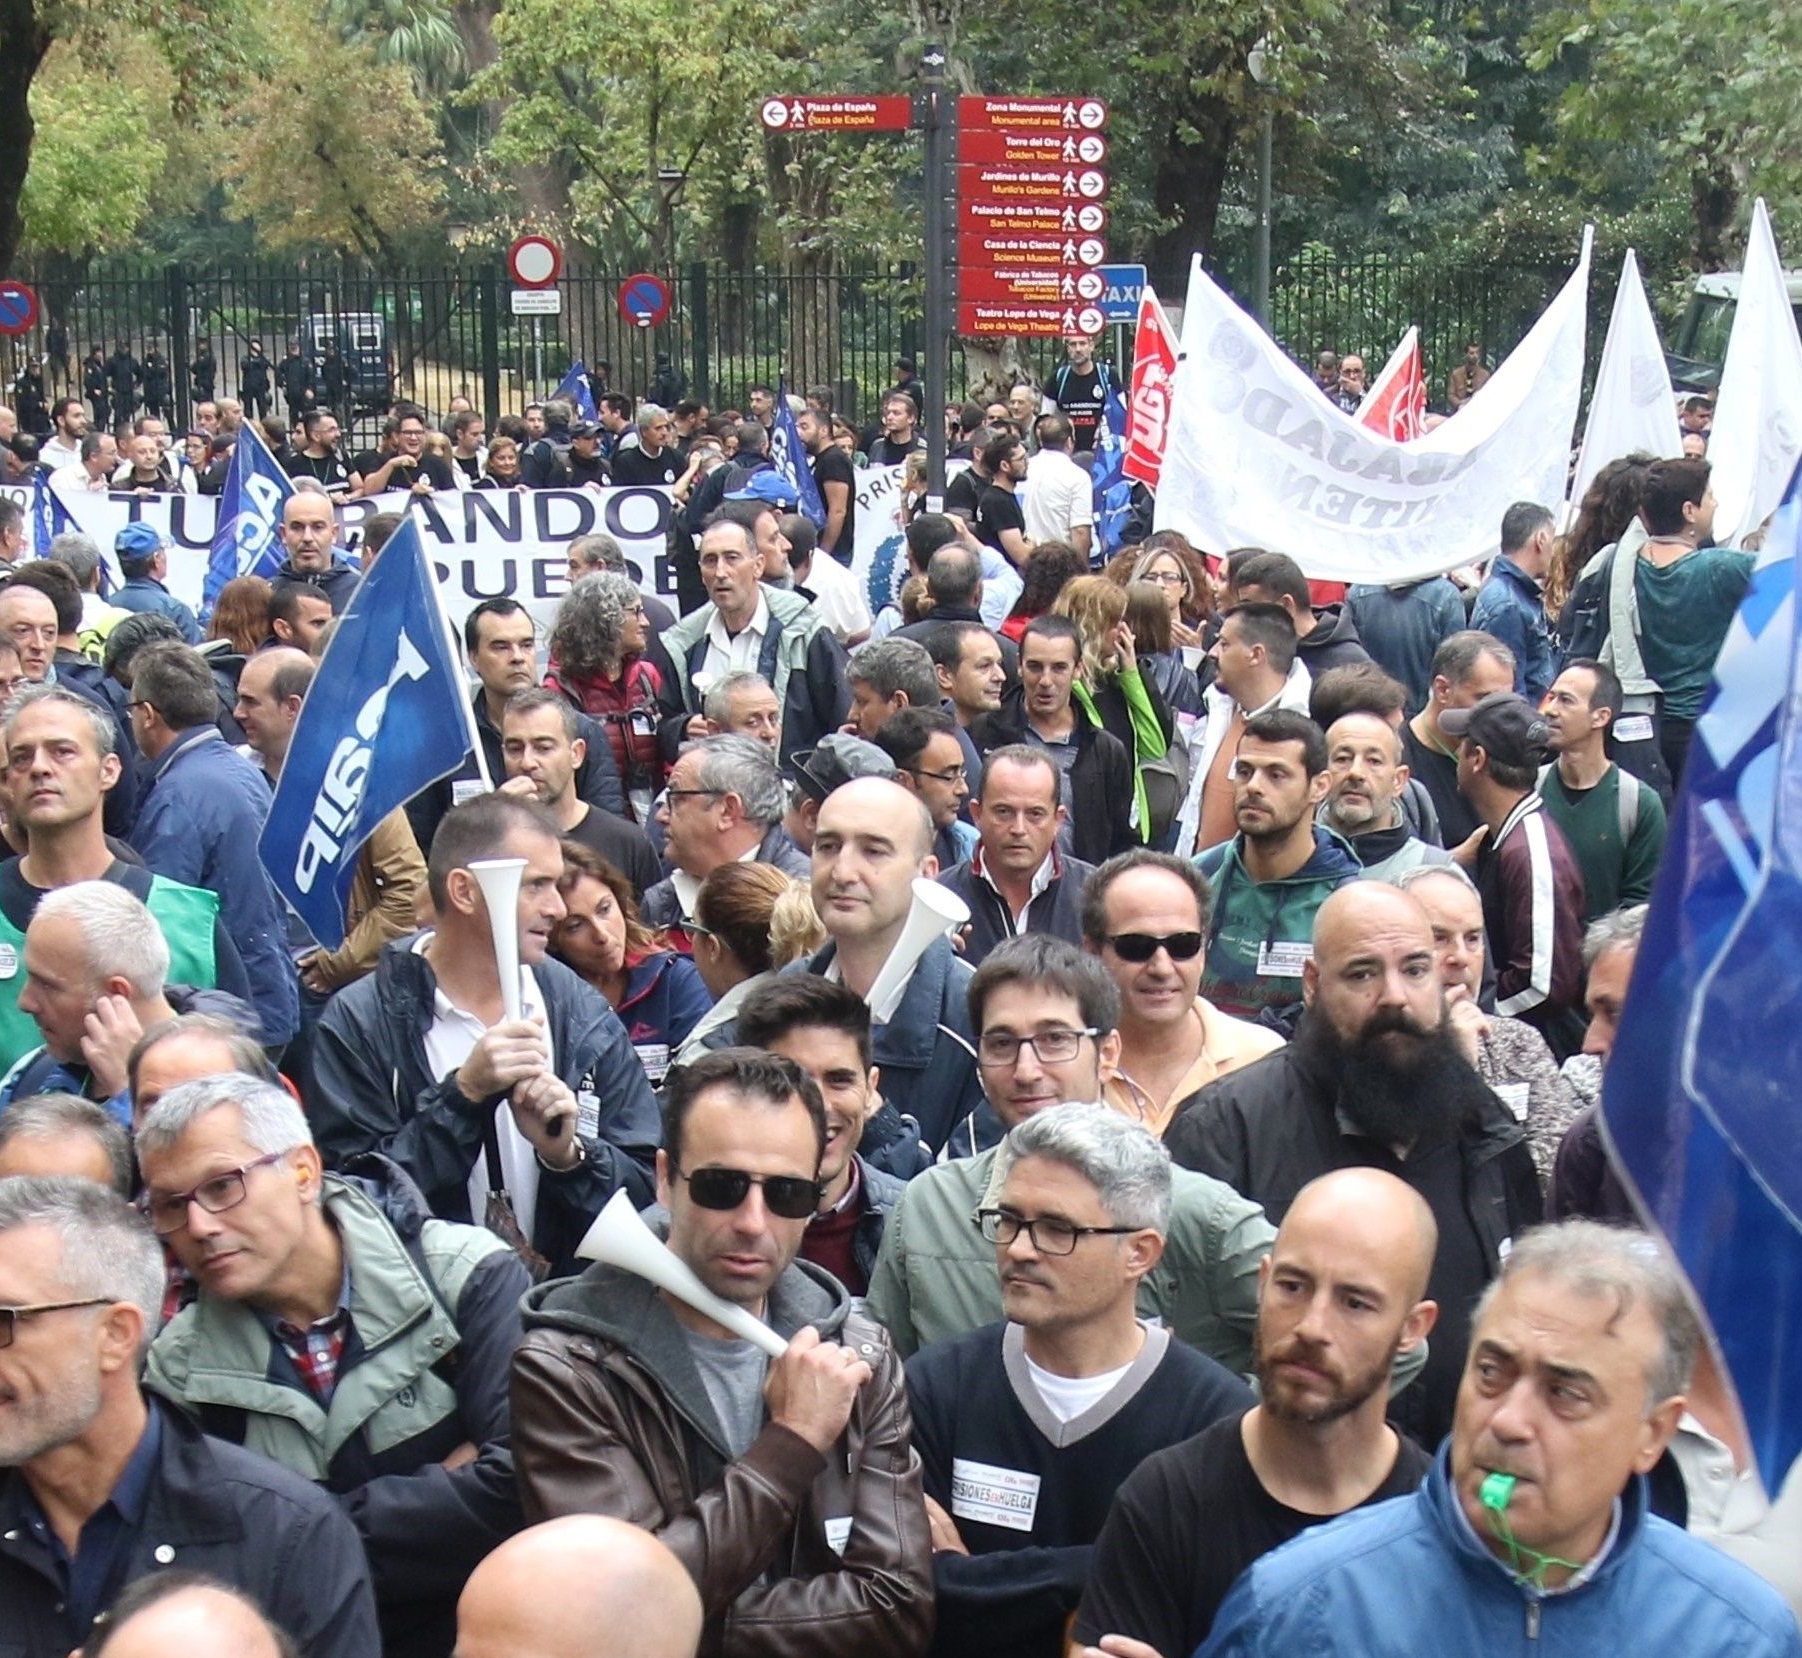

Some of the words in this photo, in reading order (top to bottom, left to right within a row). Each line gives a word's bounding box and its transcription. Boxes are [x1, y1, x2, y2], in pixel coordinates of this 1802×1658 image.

[807, 103, 830, 111] Plaza
[832, 103, 843, 111] de
[844, 103, 877, 112] España
[986, 102, 1007, 111] Zona
[1009, 103, 1060, 112] Monumental
[832, 116, 843, 124] de
[844, 115, 875, 124] España
[991, 115, 1040, 125] Monumental
[1042, 118, 1060, 126] area
[1006, 137, 1027, 146] Torre
[1029, 137, 1042, 146] del
[1044, 138, 1060, 146] Oro
[1006, 151, 1034, 159] Golden
[1036, 151, 1059, 160] Tower
[981, 172, 1017, 180] Jardines
[1019, 172, 1029, 180] de
[1031, 172, 1060, 181] Murillo
[992, 185, 1024, 194] Murillo's
[1026, 186, 1060, 195] Gardens
[971, 205, 1003, 215] Palacio
[1004, 206, 1014, 215] de
[1016, 206, 1033, 215] San
[1035, 207, 1060, 216] Telmo
[990, 219, 1006, 228] San
[1008, 219, 1031, 228] Telmo
[1032, 220, 1060, 229] Palace
[984, 240, 1005, 249] Casa
[1007, 240, 1018, 249] de
[1019, 240, 1027, 249] la
[1029, 240, 1060, 250] Ciencia
[993, 252, 1025, 261] Science
[1026, 253, 1060, 262] Museum
[975, 309, 1003, 317] Teatro
[1004, 310, 1026, 319] Lope
[1039, 311, 1060, 319] Vega
[974, 322, 995, 331] Lope
[996, 322, 1006, 330] de
[1007, 323, 1028, 332] Vega
[1029, 323, 1060, 331] Theatre
[108, 493, 224, 549] TU
